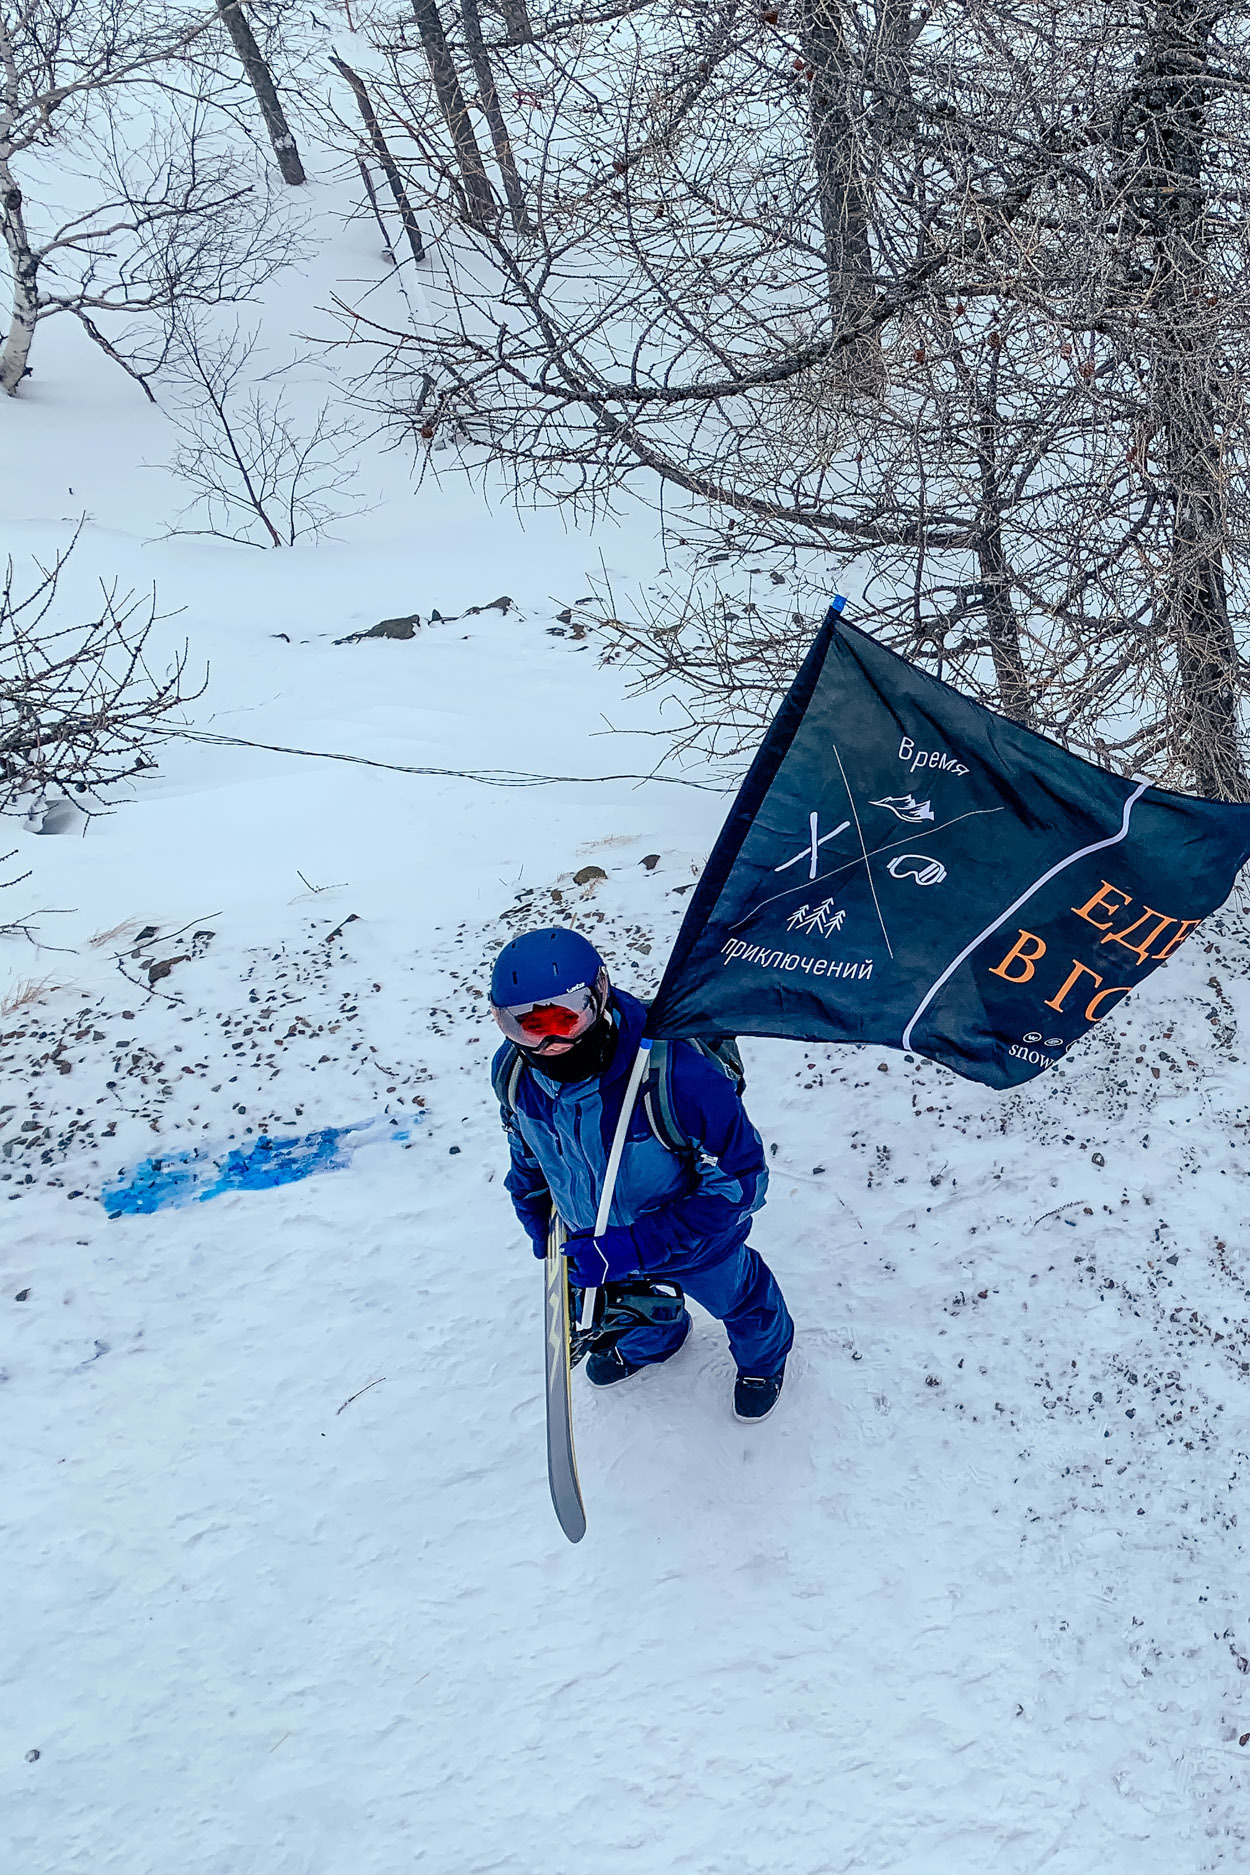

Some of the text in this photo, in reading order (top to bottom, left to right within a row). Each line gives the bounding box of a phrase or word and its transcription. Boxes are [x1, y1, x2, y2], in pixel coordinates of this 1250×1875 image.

[898, 736, 970, 777] Время
[720, 937, 874, 981] приключений
[988, 929, 1047, 983] В
